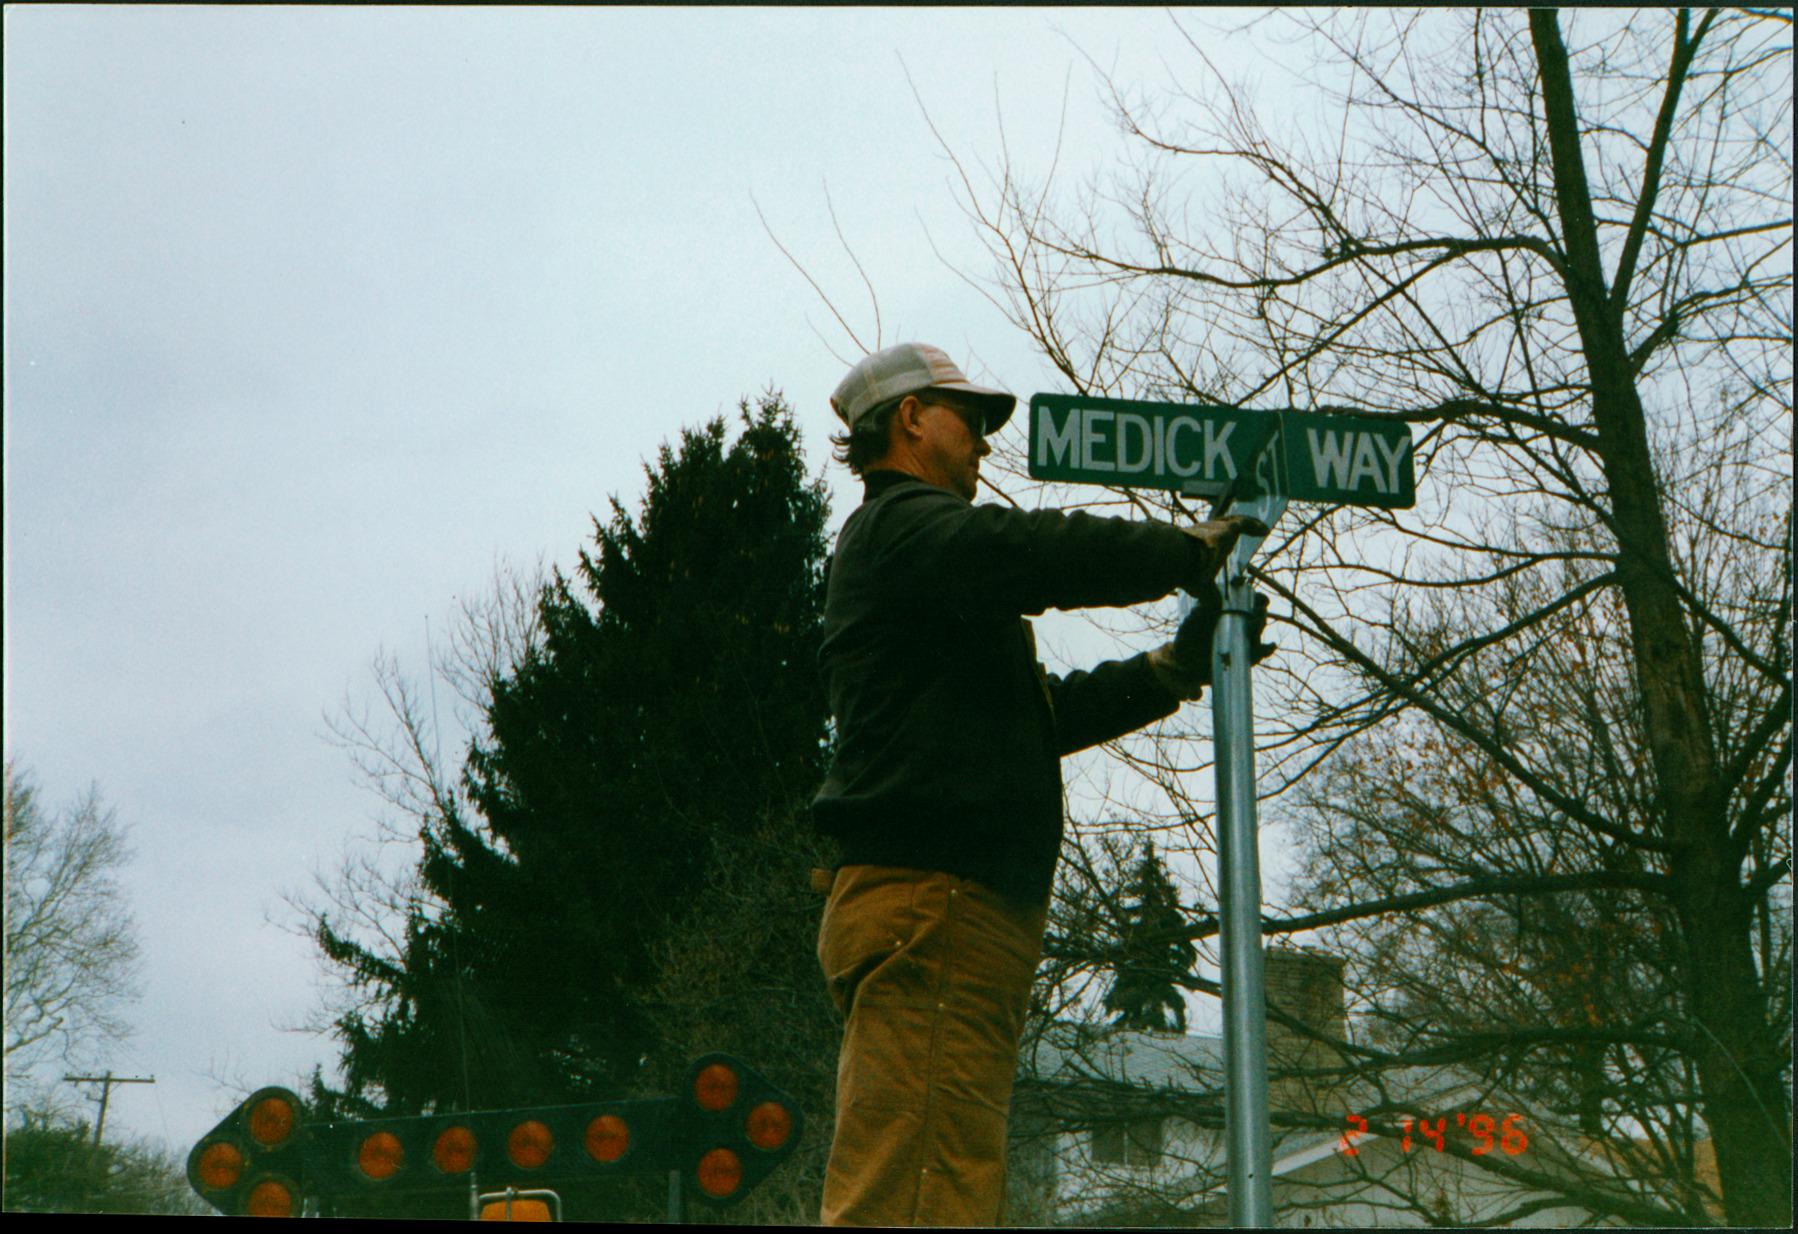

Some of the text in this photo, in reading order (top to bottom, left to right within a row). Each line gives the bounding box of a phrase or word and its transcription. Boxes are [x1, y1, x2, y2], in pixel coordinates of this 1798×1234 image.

[1036, 406, 1411, 494] MEDICK WAY
[1255, 430, 1280, 522] ST
